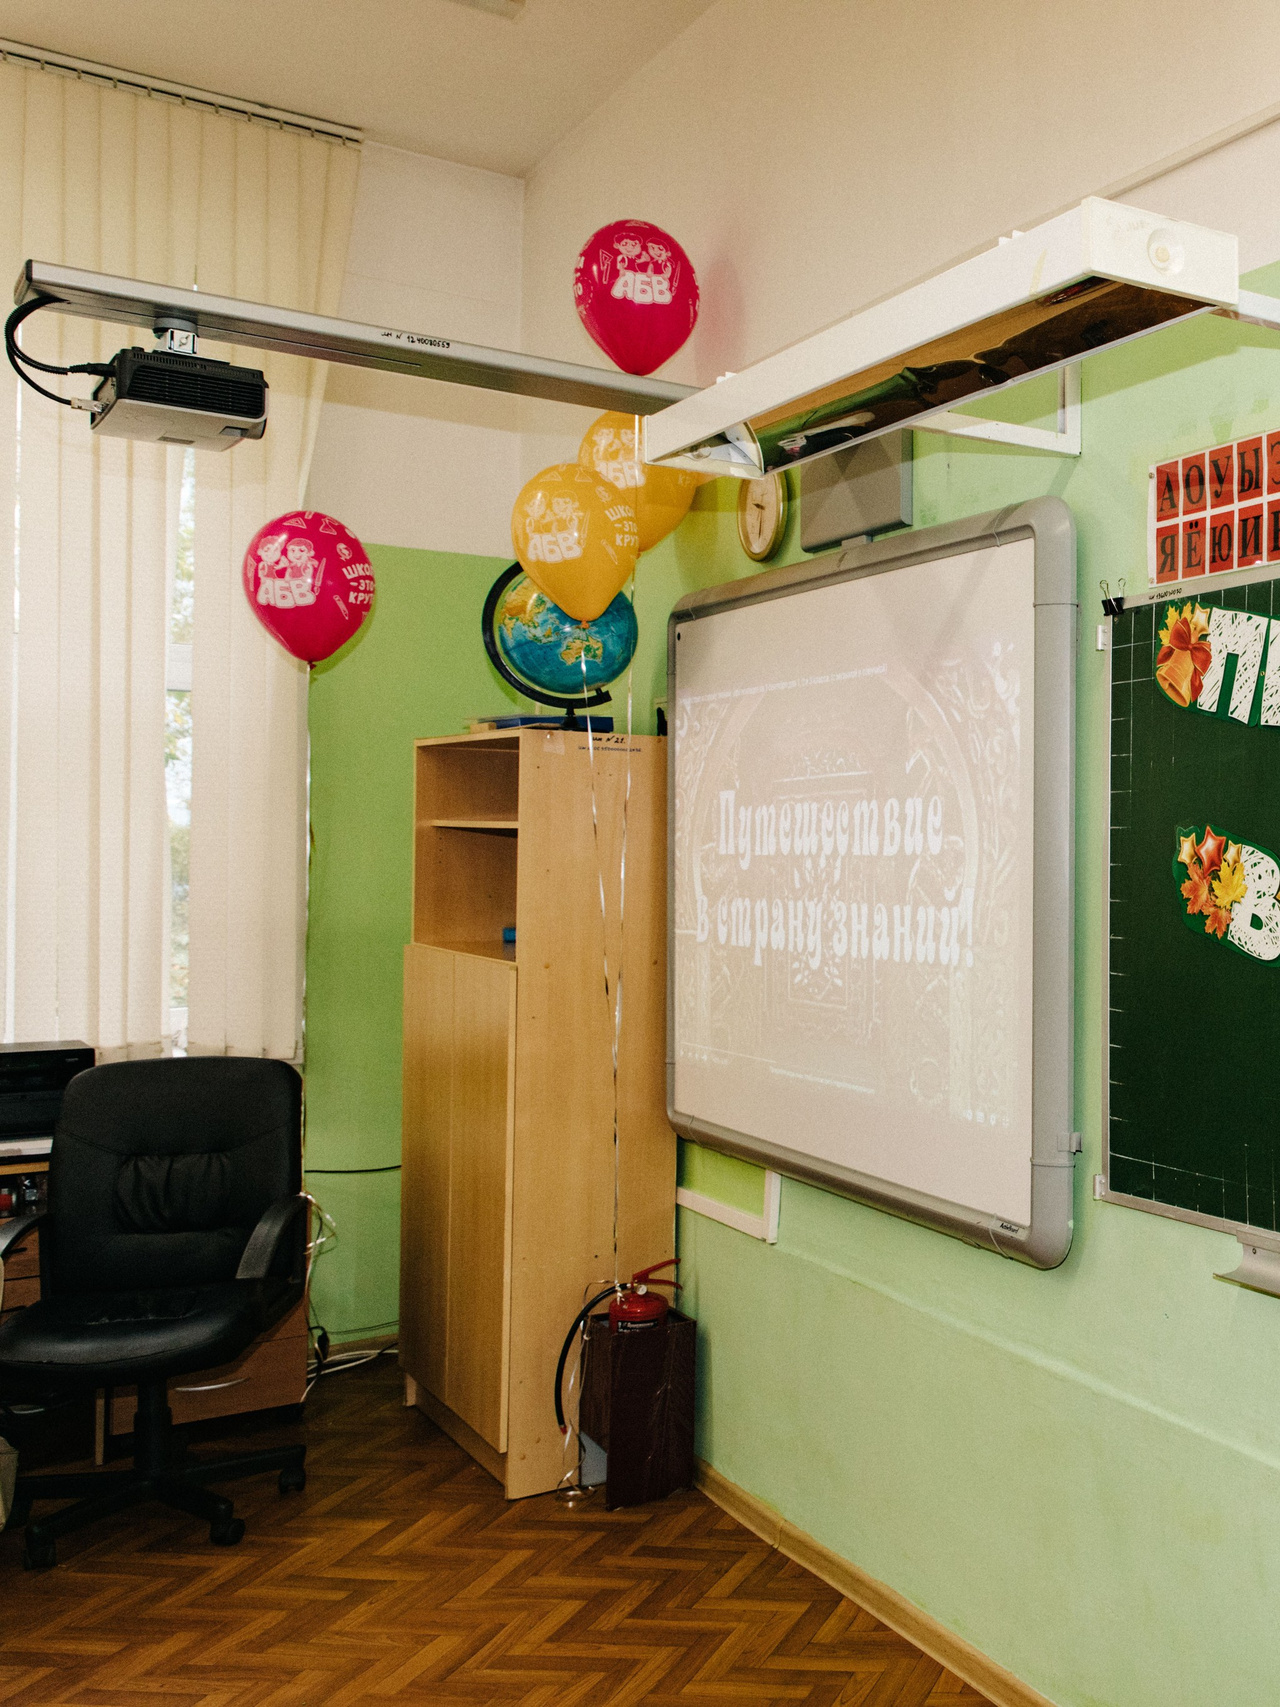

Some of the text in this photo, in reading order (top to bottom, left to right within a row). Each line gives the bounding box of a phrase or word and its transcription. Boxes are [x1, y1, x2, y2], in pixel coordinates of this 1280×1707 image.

[611, 271, 673, 305] АБВ
[1159, 472, 1178, 512] А
[1184, 464, 1205, 505] О
[1211, 456, 1231, 499] У
[1239, 447, 1261, 494] Ы
[604, 504, 637, 522] ШКО
[527, 531, 584, 564] АБВ
[1158, 533, 1178, 575] Я
[1185, 520, 1203, 569] Ё
[1210, 523, 1232, 564] Ю
[1238, 514, 1264, 559] И
[341, 563, 373, 580] ШКО
[256, 577, 317, 609] АБВ
[718, 789, 943, 870] Путешествие
[716, 896, 823, 970] страну
[831, 887, 975, 968] знаний!
